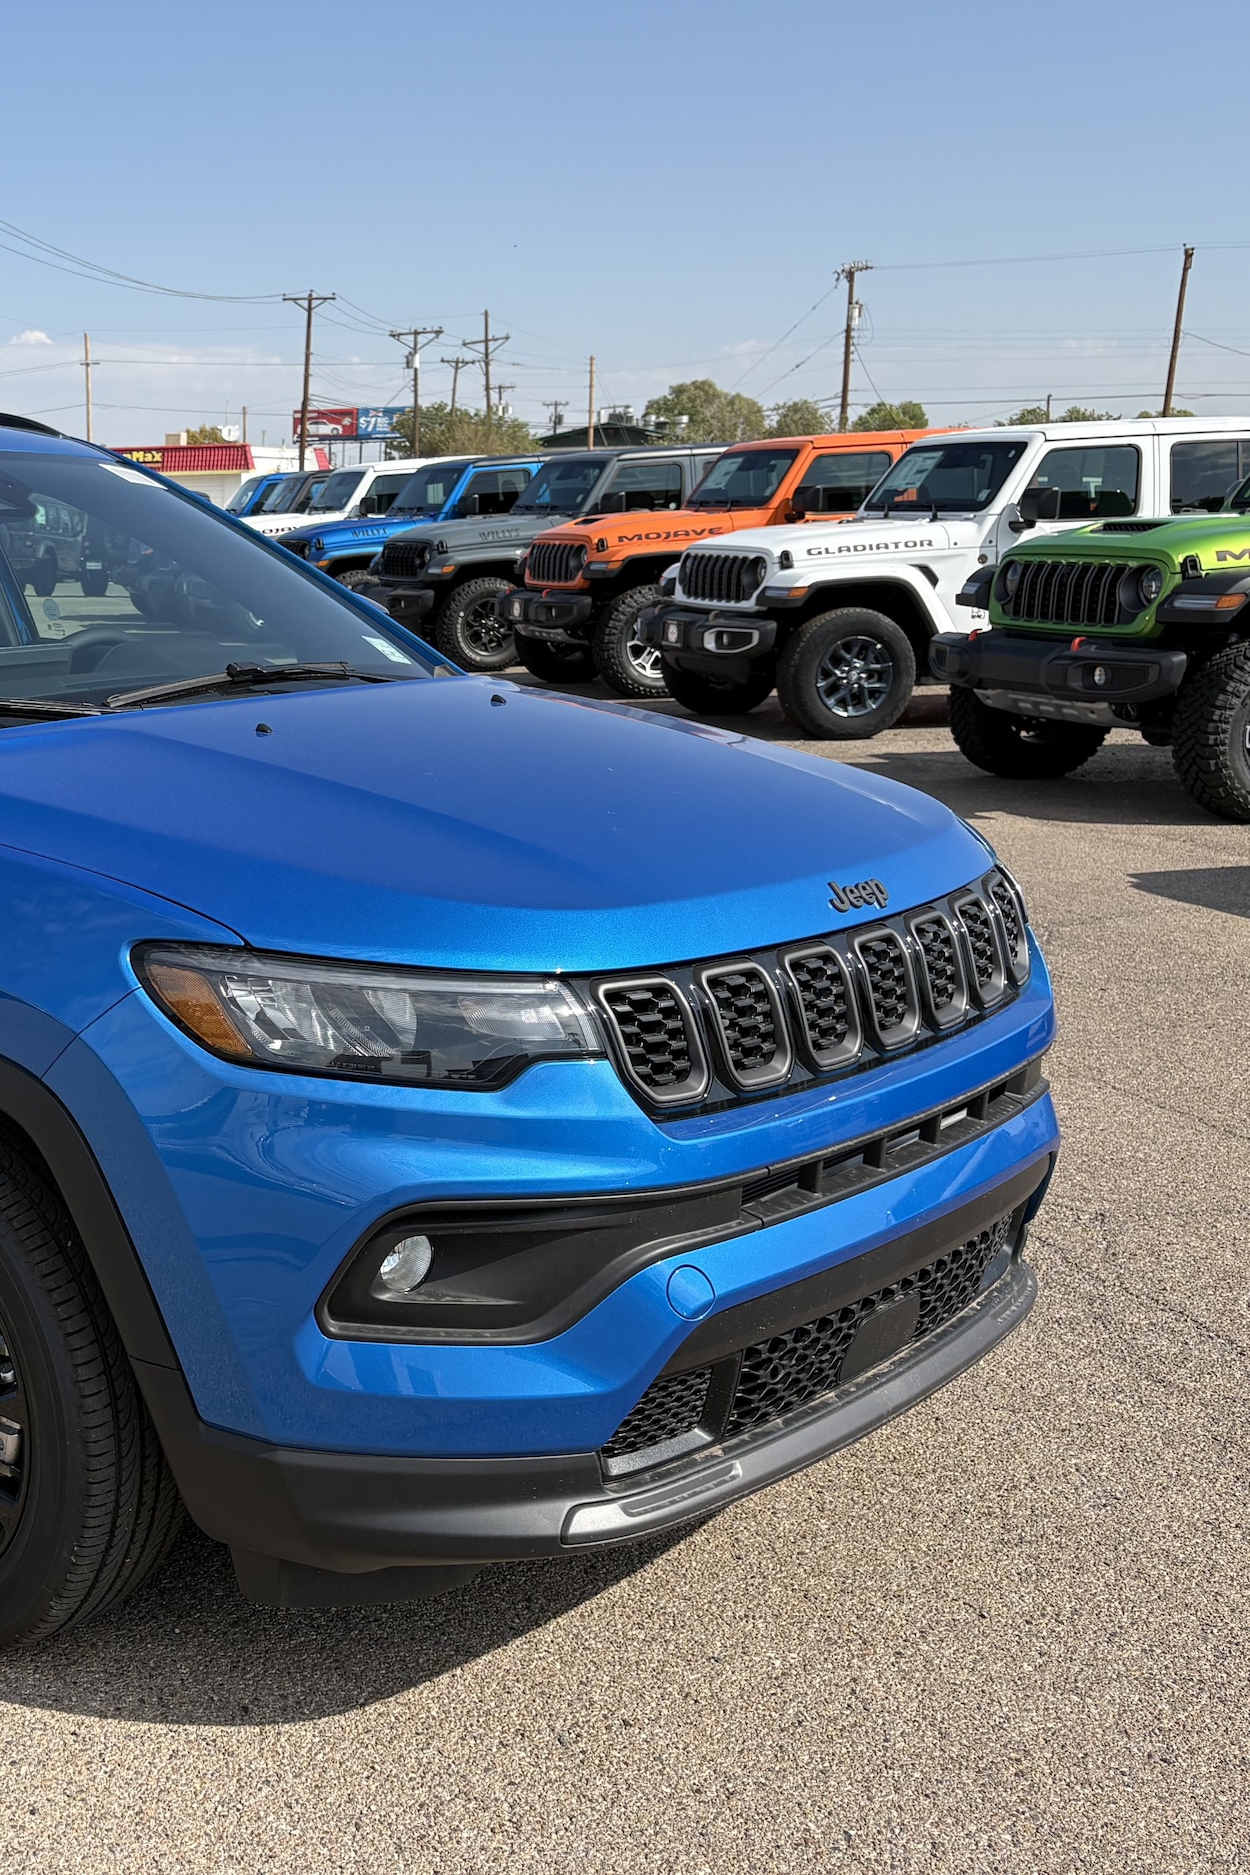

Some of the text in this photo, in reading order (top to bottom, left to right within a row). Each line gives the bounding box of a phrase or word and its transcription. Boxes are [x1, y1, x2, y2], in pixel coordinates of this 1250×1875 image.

[350, 527, 388, 538] WILLYS
[478, 528, 521, 541] WILLYS
[617, 526, 724, 543] MOJAVE
[806, 539, 934, 556] GLADIATOR
[827, 878, 889, 913] Jeep
